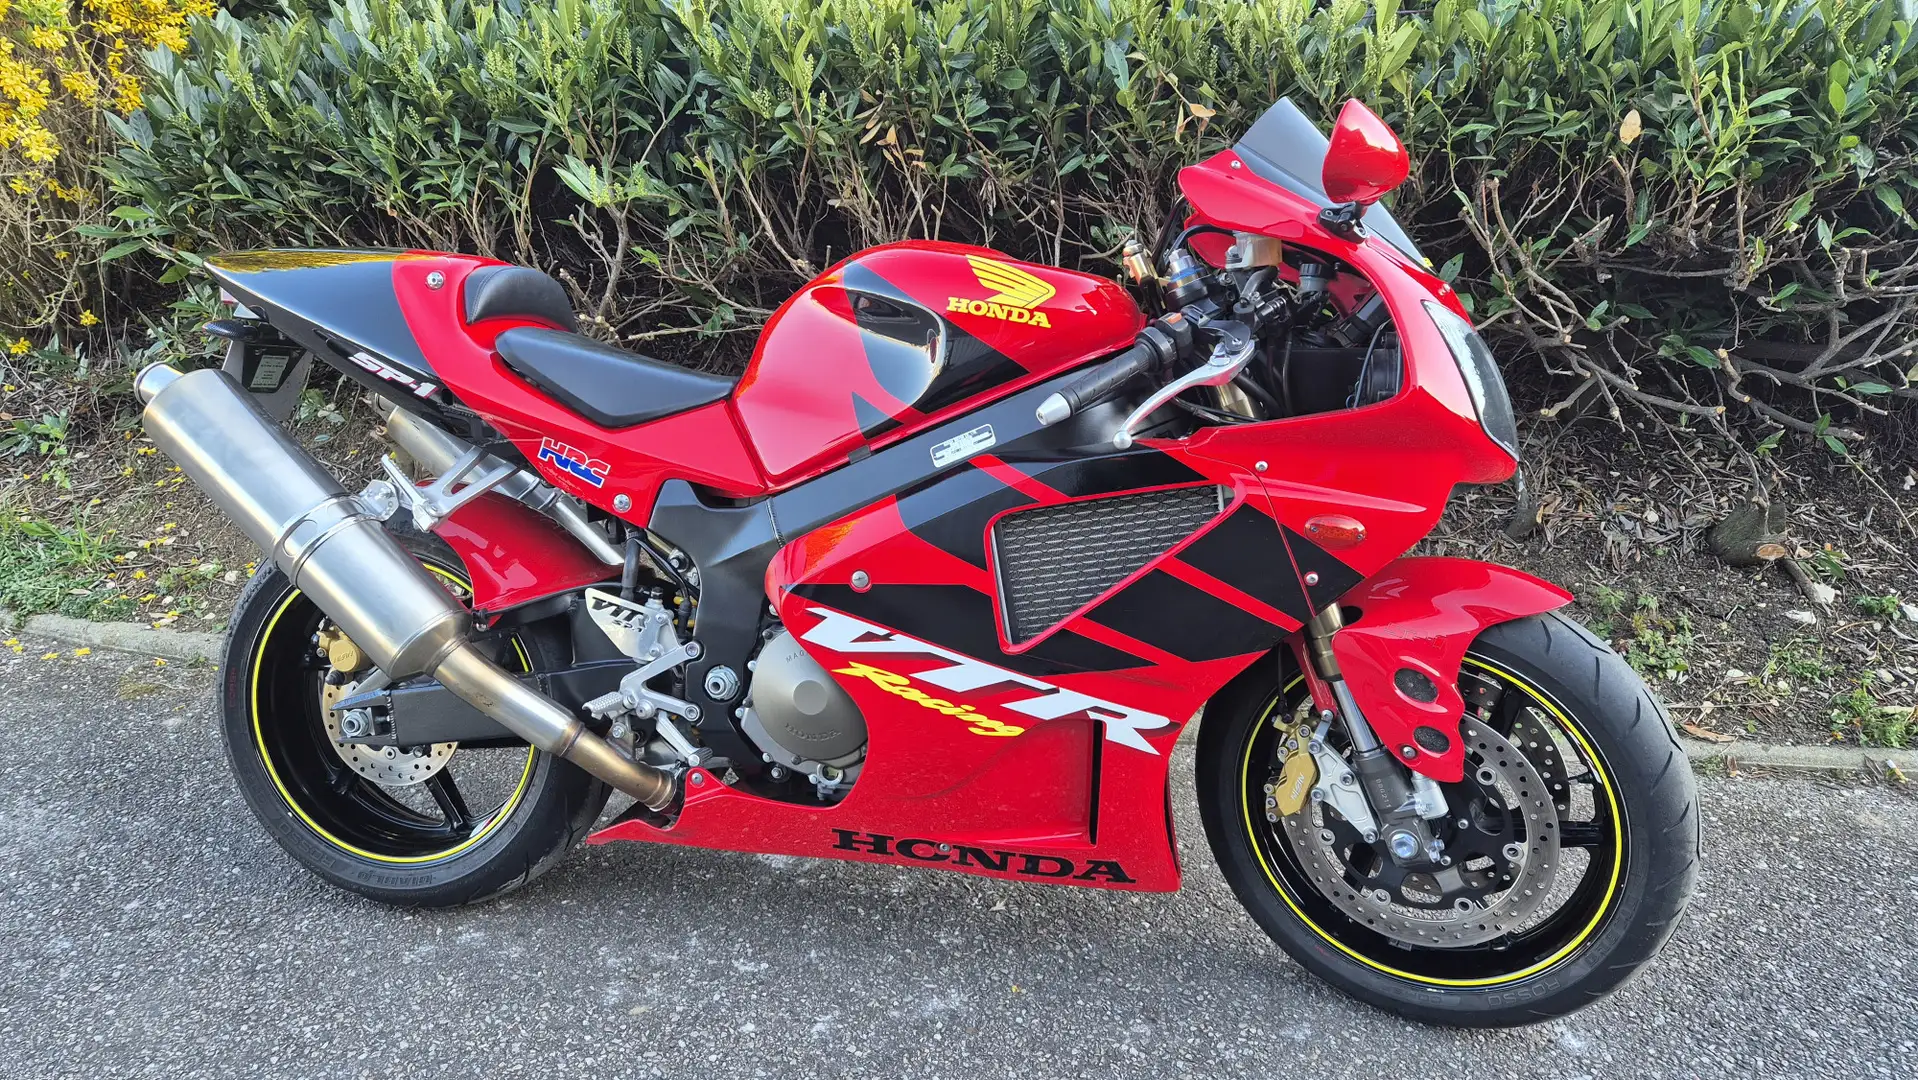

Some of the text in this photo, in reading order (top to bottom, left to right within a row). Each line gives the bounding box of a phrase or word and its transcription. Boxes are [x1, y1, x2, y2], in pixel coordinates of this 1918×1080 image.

[946, 297, 1052, 328] HONDA
[347, 352, 438, 398] SP-1
[537, 436, 611, 489] HRC
[800, 607, 1172, 755] VTR
[832, 661, 1026, 737] Racing
[832, 829, 1136, 883] HONDA
[1488, 977, 1562, 1009] ROSSO
